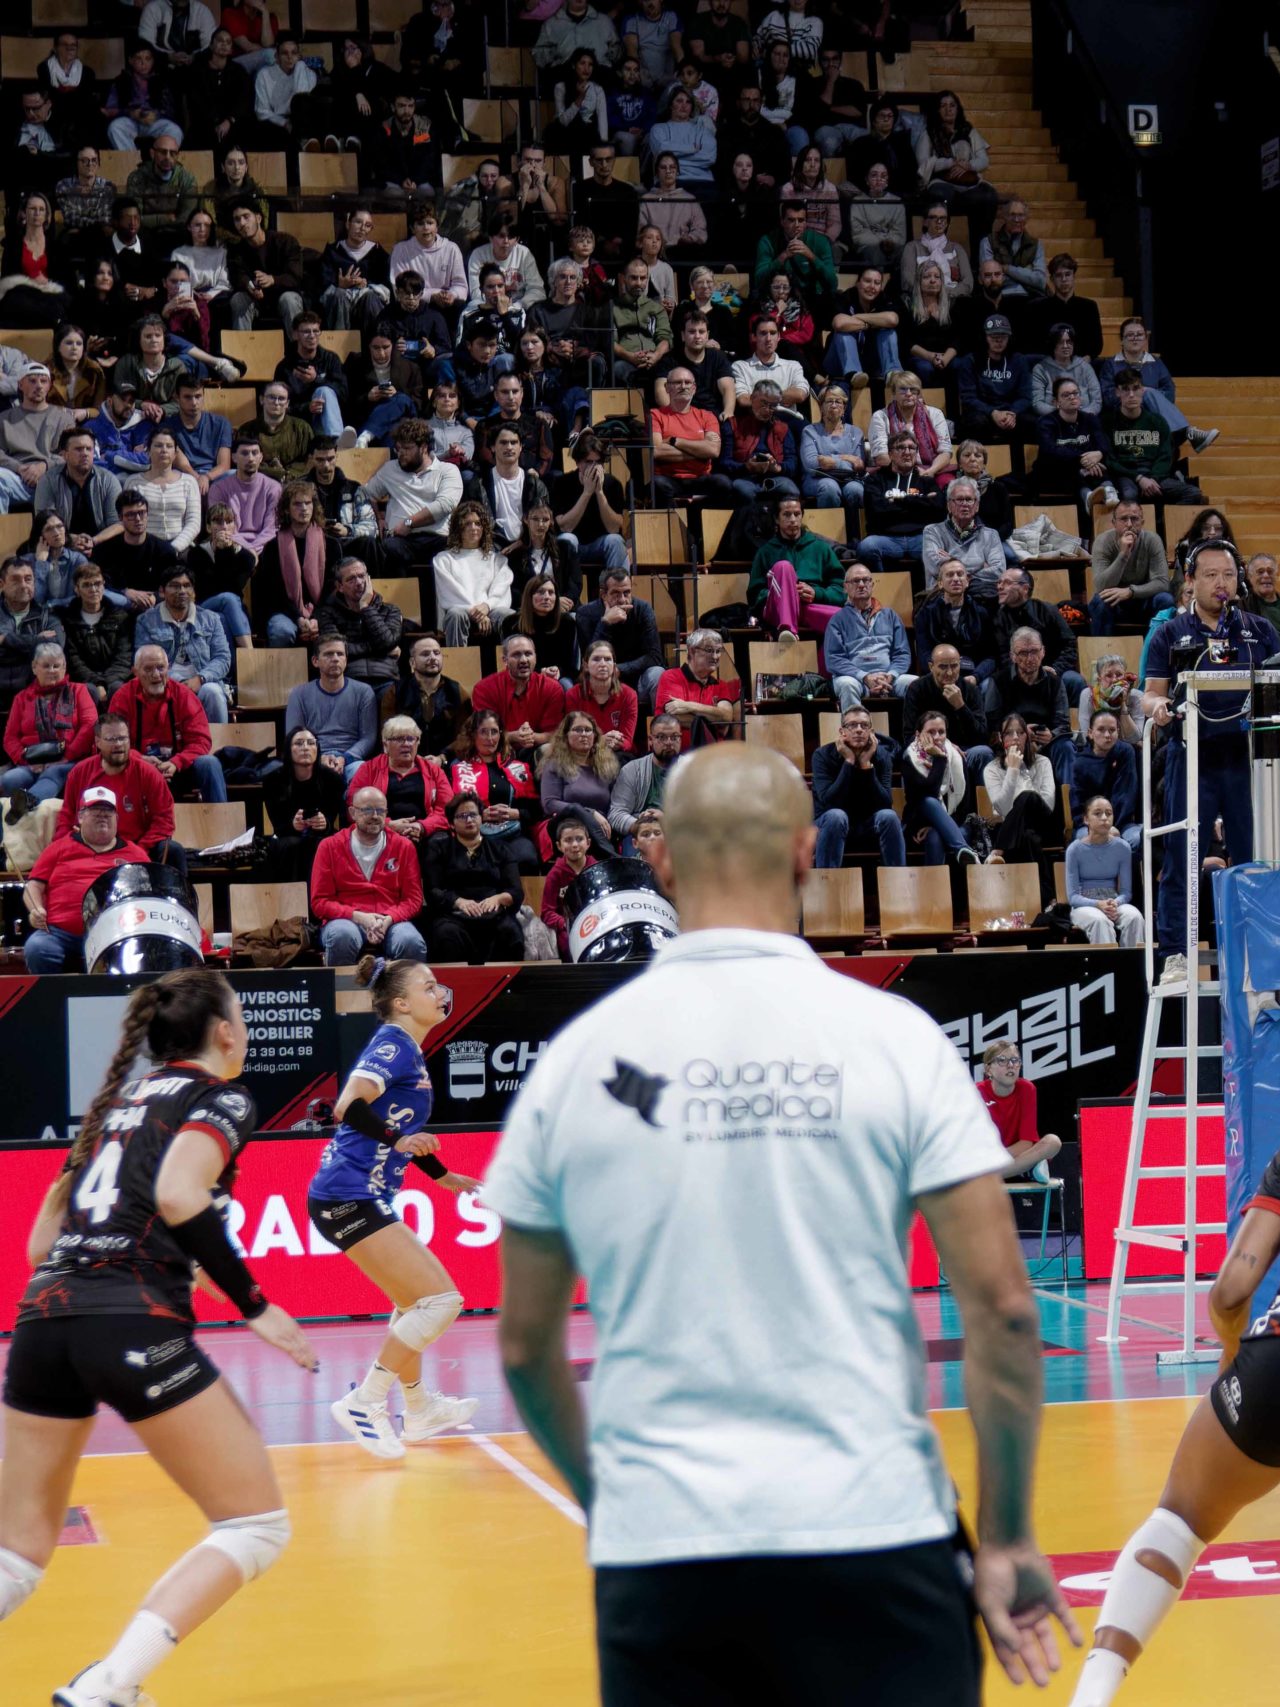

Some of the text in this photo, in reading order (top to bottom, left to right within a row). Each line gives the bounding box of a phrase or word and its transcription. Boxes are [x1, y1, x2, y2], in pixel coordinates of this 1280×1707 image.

[1133, 109, 1154, 131] D
[1191, 917, 1197, 926] DE
[238, 990, 309, 1005] UVERGNE
[242, 1008, 322, 1023] GNOSTICS
[247, 1026, 314, 1041] MOBILIER
[260, 1047, 276, 1057] 39
[279, 1046, 294, 1056] 04
[297, 1046, 313, 1056] 98
[491, 1041, 549, 1073] CH
[243, 1063, 301, 1074] di-diag.com
[75, 1140, 124, 1224] 4
